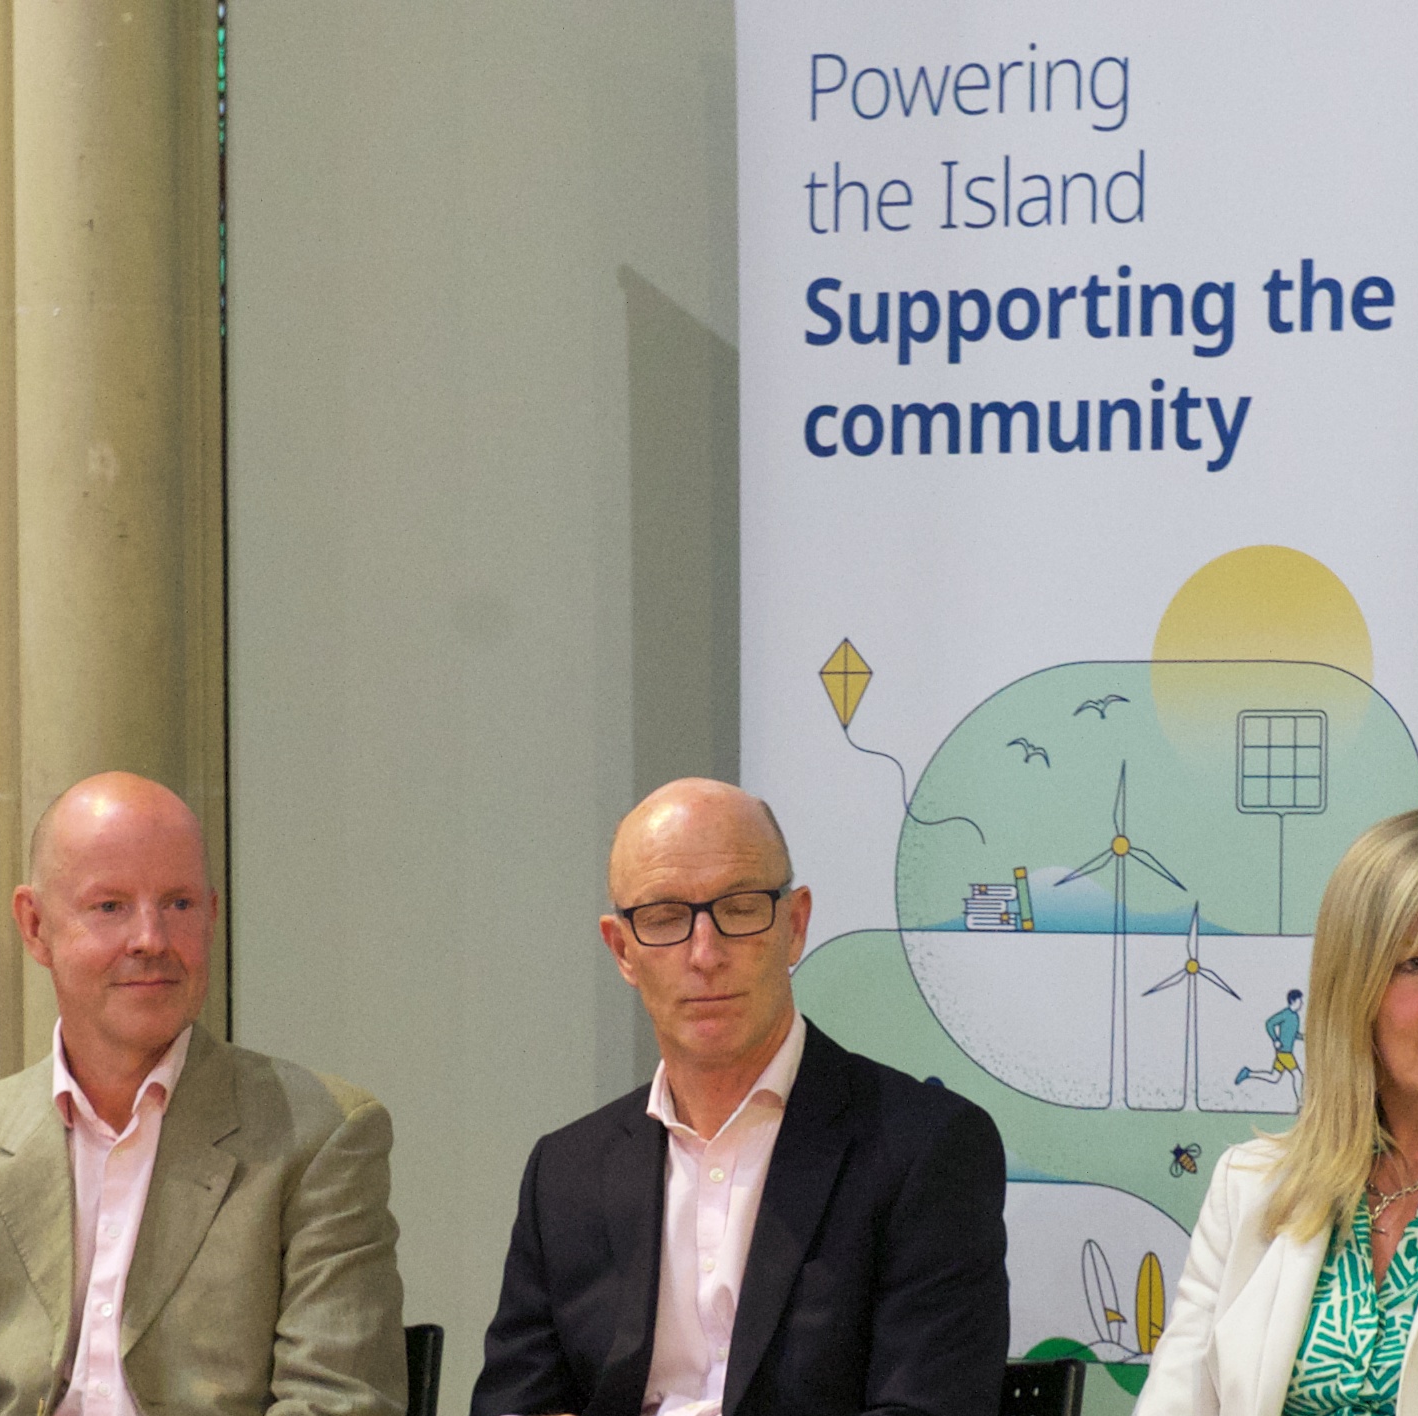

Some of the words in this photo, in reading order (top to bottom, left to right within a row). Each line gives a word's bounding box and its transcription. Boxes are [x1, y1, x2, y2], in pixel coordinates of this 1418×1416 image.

[811, 43, 1129, 132] Powering
[804, 162, 913, 234] the
[941, 150, 1145, 229] Island
[805, 265, 1235, 365] Supporting
[1263, 259, 1395, 333] the
[804, 378, 1251, 472] community
